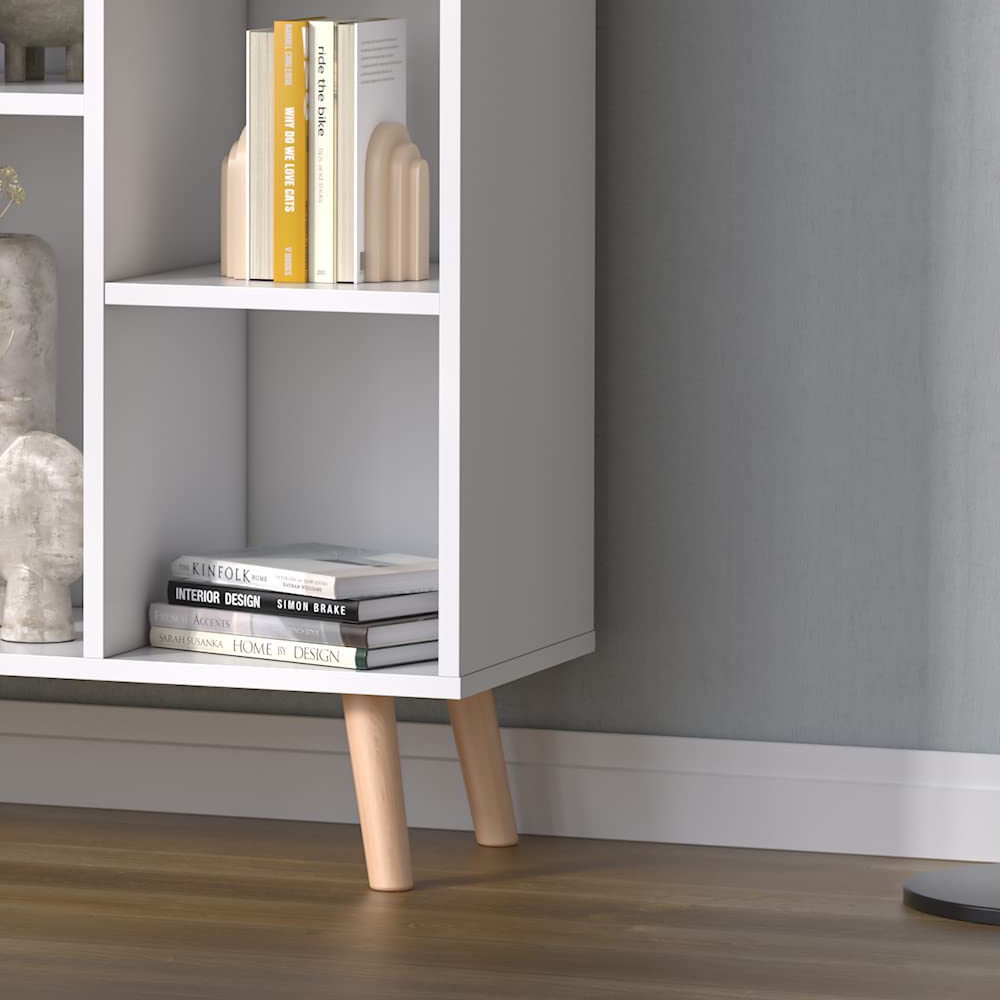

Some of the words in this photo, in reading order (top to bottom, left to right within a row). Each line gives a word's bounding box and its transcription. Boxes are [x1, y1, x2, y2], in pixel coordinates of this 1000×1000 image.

[318, 46, 326, 73] ride
[318, 79, 326, 102] the
[284, 107, 295, 128] WHY
[318, 106, 326, 136] bike
[284, 131, 295, 144] DO
[284, 146, 295, 161] WE
[284, 163, 295, 186] LOVE
[284, 188, 295, 213] CATS
[192, 562, 250, 583] KINFOLK
[251, 574, 267, 582] HOME
[175, 587, 220, 604] INTERIOR
[225, 592, 261, 608] DESIGN
[276, 599, 309, 612] SIMON
[313, 602, 346, 616] BRAKE
[159, 634, 185, 644] SARAH
[185, 637, 223, 649] SUSANKA
[233, 639, 273, 656] HOME
[277, 646, 287, 656] BY
[294, 645, 341, 663] DESIGN
